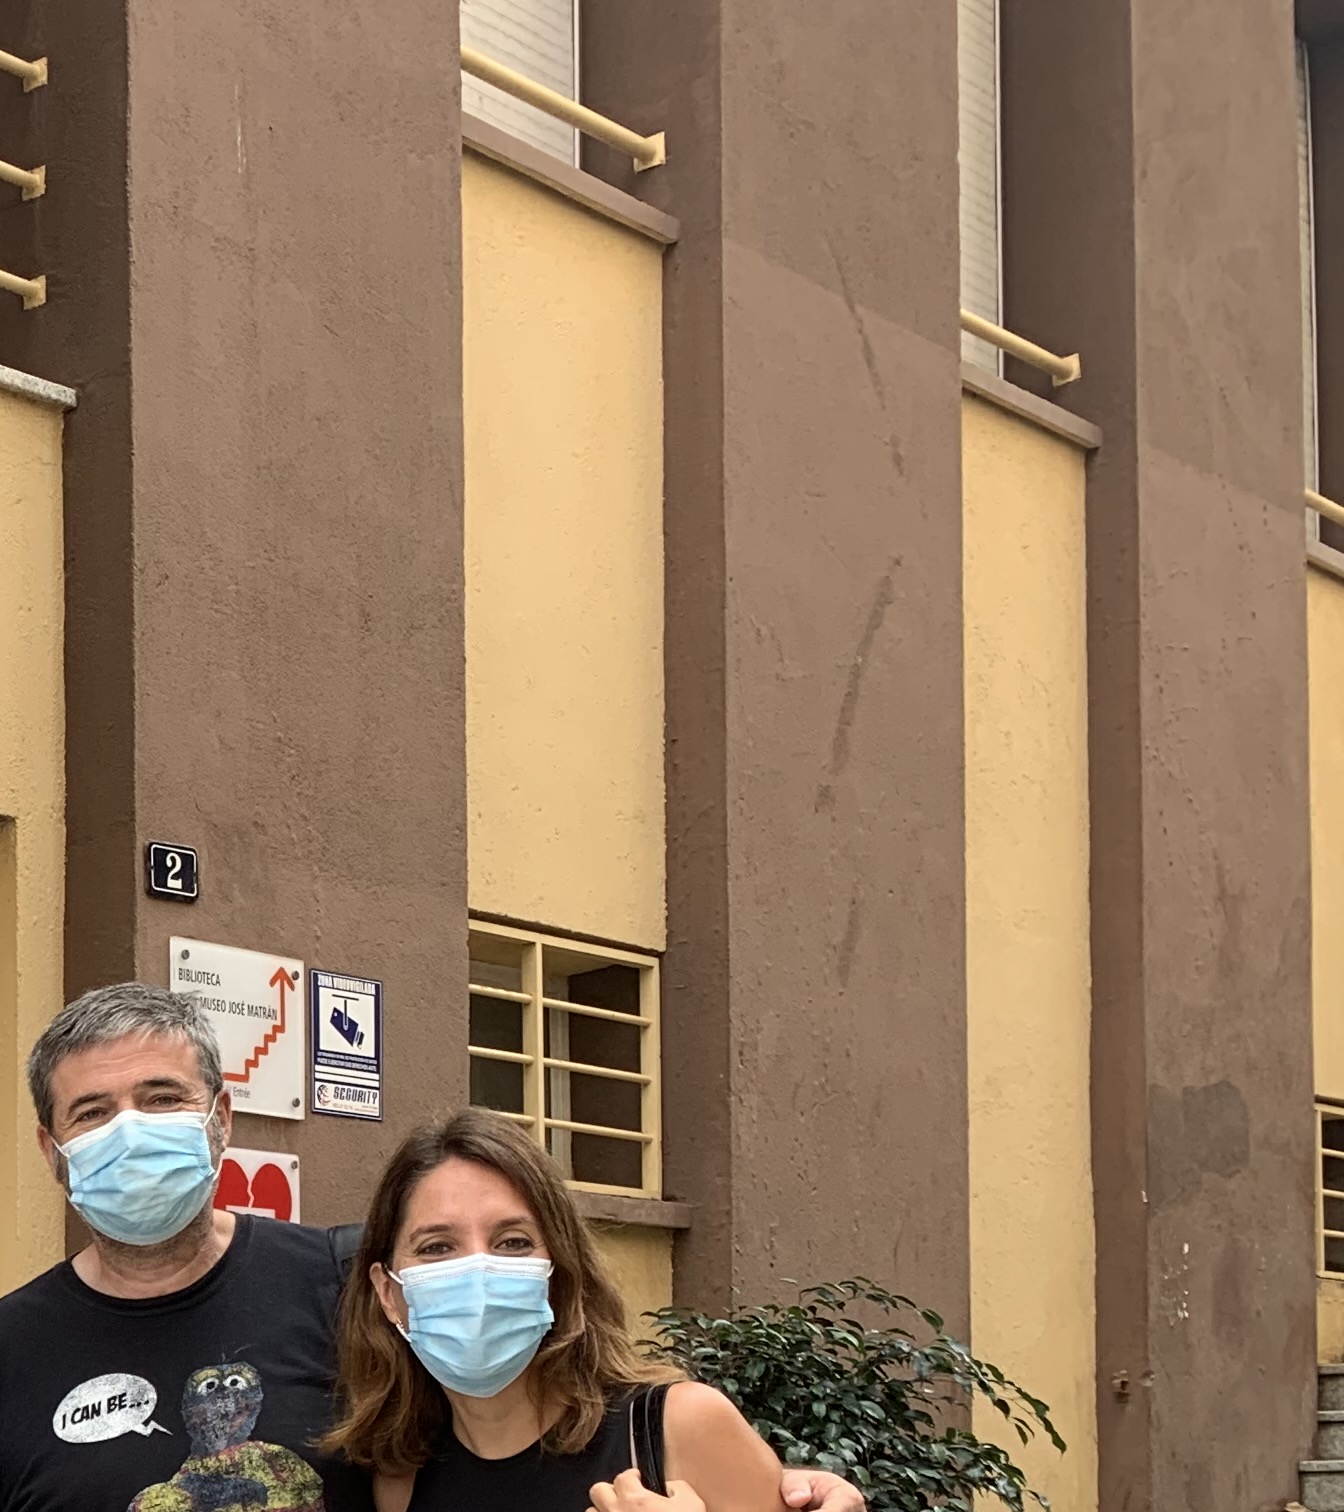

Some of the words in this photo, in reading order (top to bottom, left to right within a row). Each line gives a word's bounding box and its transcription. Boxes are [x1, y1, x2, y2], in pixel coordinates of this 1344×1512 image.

[166, 852, 182, 890] 2
[178, 968, 221, 987] BIBLIOTECA
[200, 996, 226, 1013] MUSEO
[228, 1001, 245, 1016] JOSÉ
[247, 1004, 277, 1021] MATRÁN
[334, 1086, 378, 1104] SECURITY
[61, 1414, 68, 1430] I
[71, 1401, 102, 1426] CAN
